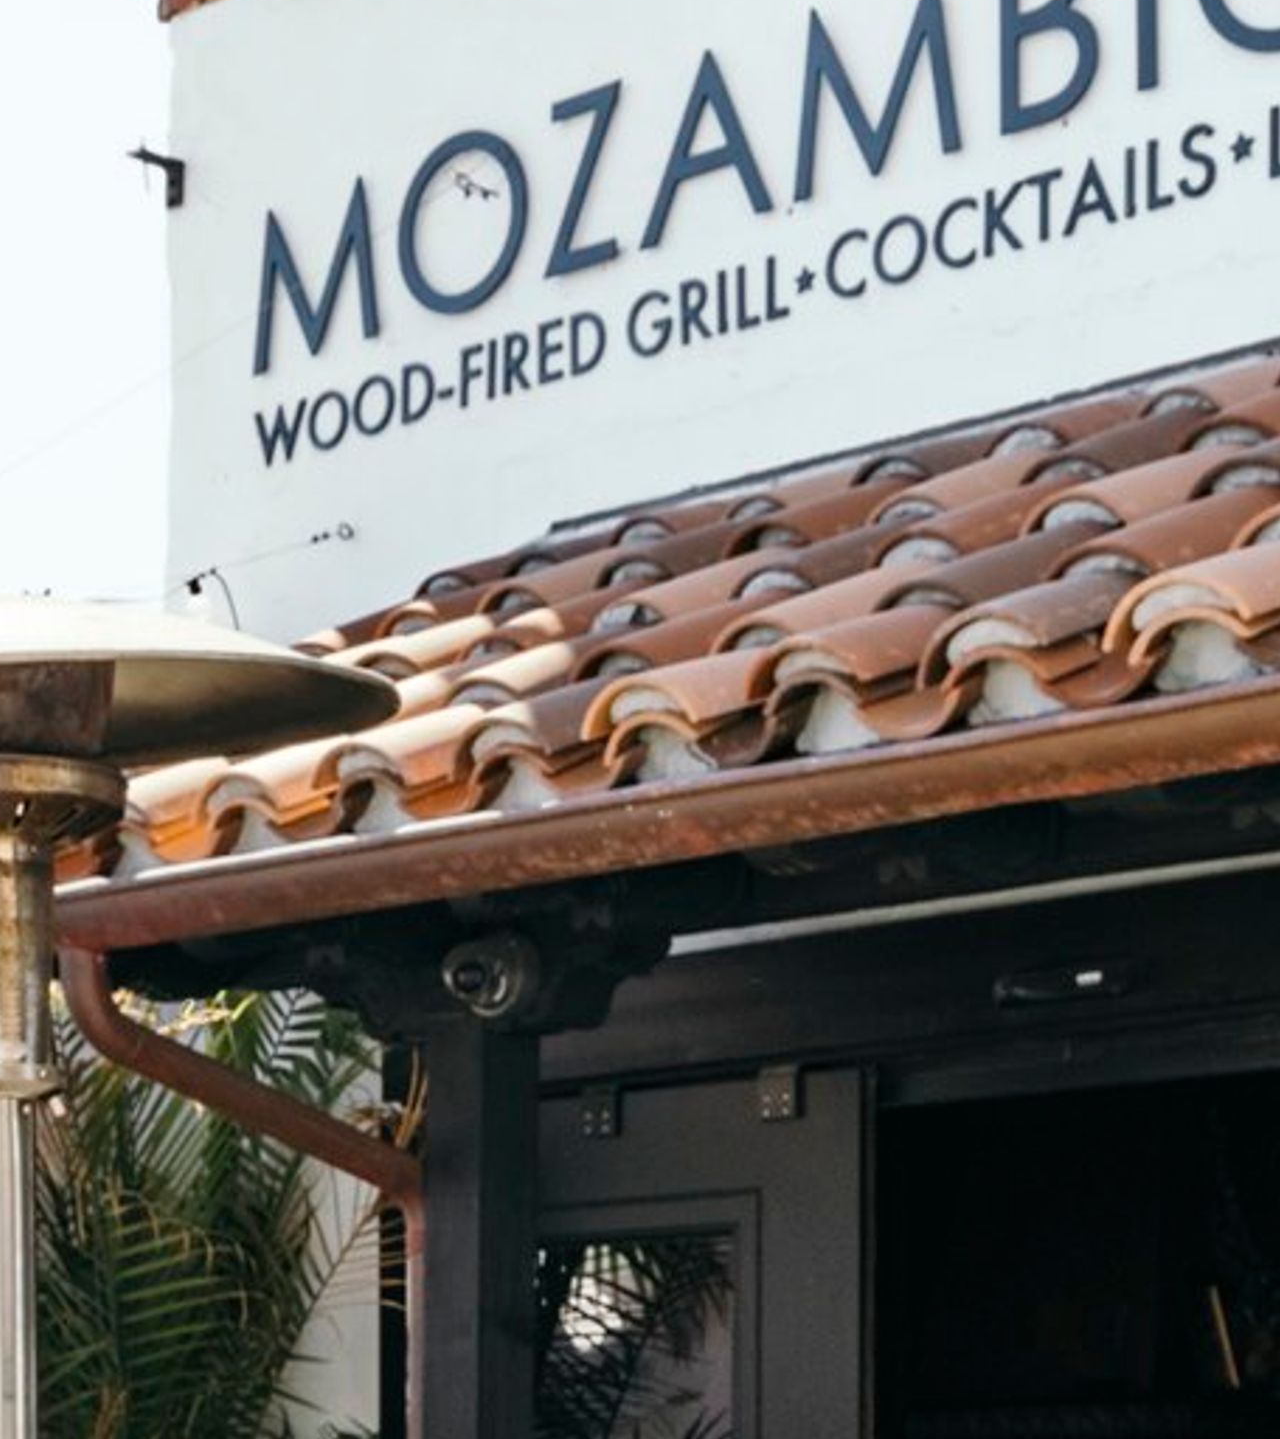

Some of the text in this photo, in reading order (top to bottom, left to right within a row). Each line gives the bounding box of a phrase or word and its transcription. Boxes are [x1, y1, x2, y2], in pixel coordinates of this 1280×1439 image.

[253, 311, 608, 469] WOOD-FIRED
[626, 254, 792, 359] GRILL
[824, 122, 1218, 300] COCKTAILS
